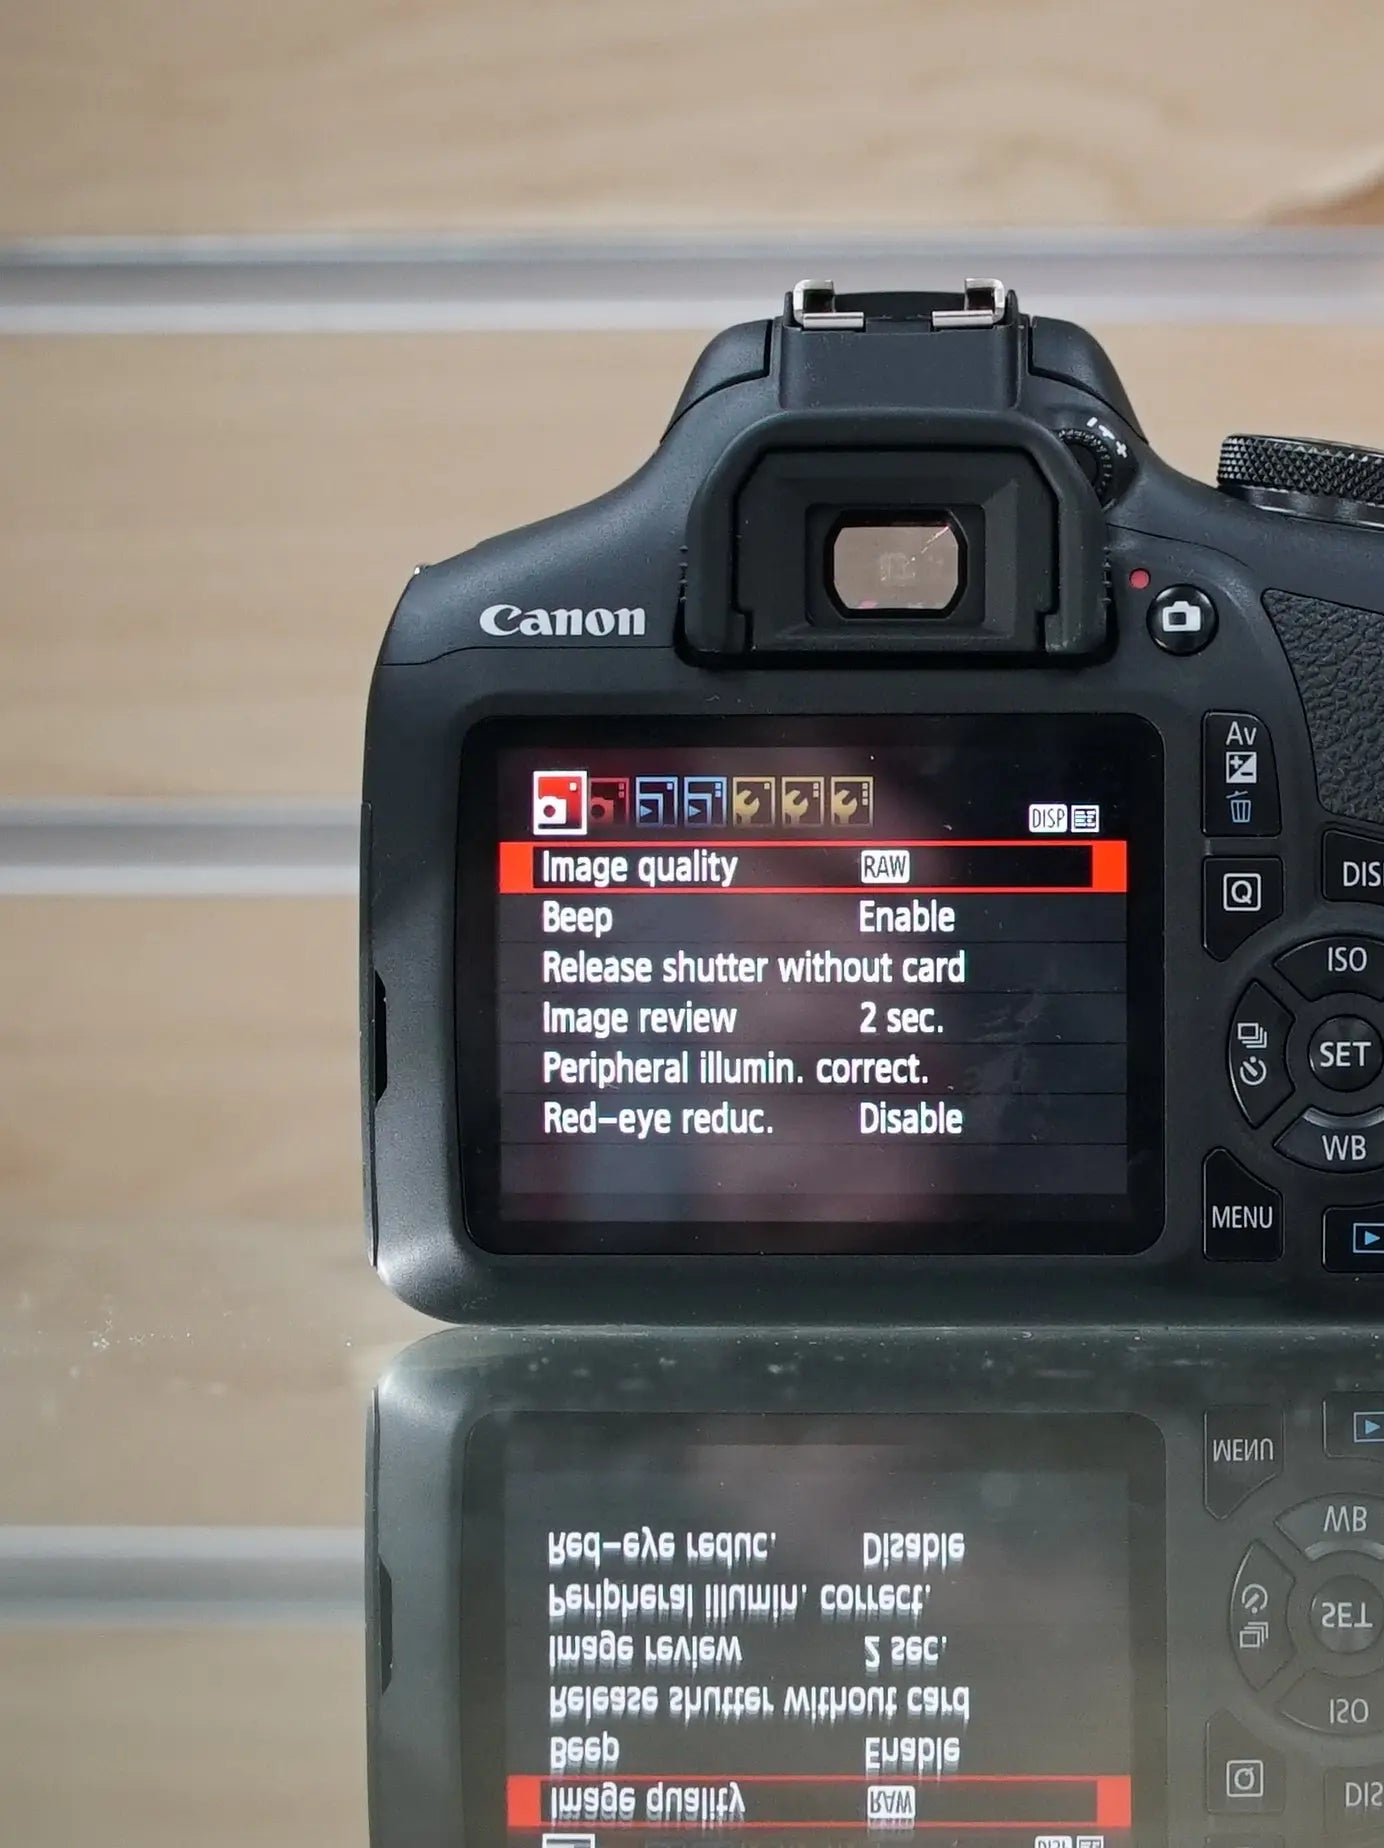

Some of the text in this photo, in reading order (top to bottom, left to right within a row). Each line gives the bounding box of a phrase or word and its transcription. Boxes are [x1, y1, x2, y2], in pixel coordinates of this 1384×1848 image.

[479, 604, 646, 636] Canon
[1225, 720, 1257, 746] Av
[1031, 807, 1067, 830] DISP
[543, 848, 907, 887] Image quality RAW
[1231, 880, 1253, 905] Q
[543, 898, 956, 939] Beep Enable
[543, 949, 965, 983] Release shutter without card
[1328, 946, 1368, 972] ISO
[543, 1000, 944, 1039] Image review 2 sec.
[1319, 1041, 1372, 1068] SET
[543, 1050, 928, 1089] Peripheral illumin. correct.
[544, 1100, 963, 1140] Red-eye reduc. Disable
[1321, 1135, 1367, 1161] WB
[1212, 1205, 1273, 1229] MENU
